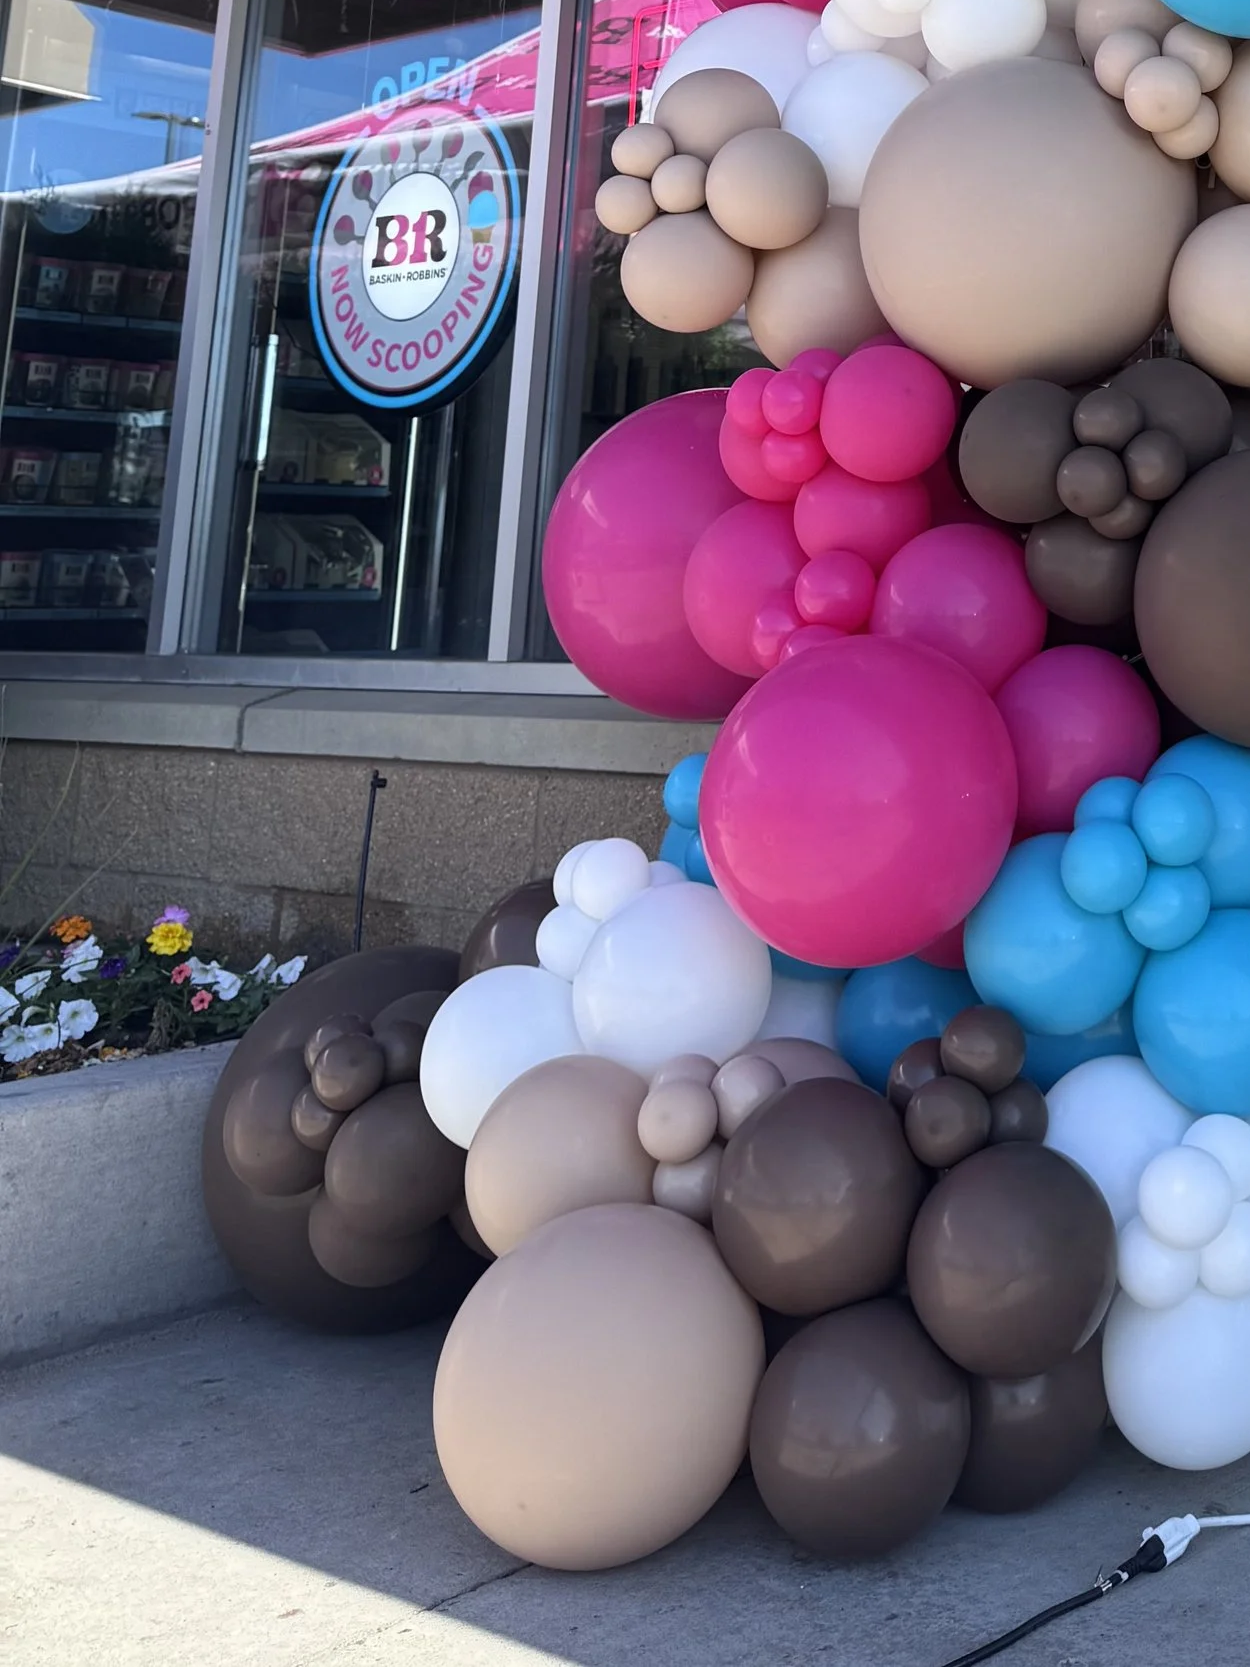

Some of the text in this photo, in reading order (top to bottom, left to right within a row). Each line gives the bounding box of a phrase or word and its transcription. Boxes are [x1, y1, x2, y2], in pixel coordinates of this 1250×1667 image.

[372, 56, 481, 121] OPEN
[371, 209, 447, 269] BR
[330, 243, 494, 373] NOW SCOOPING
